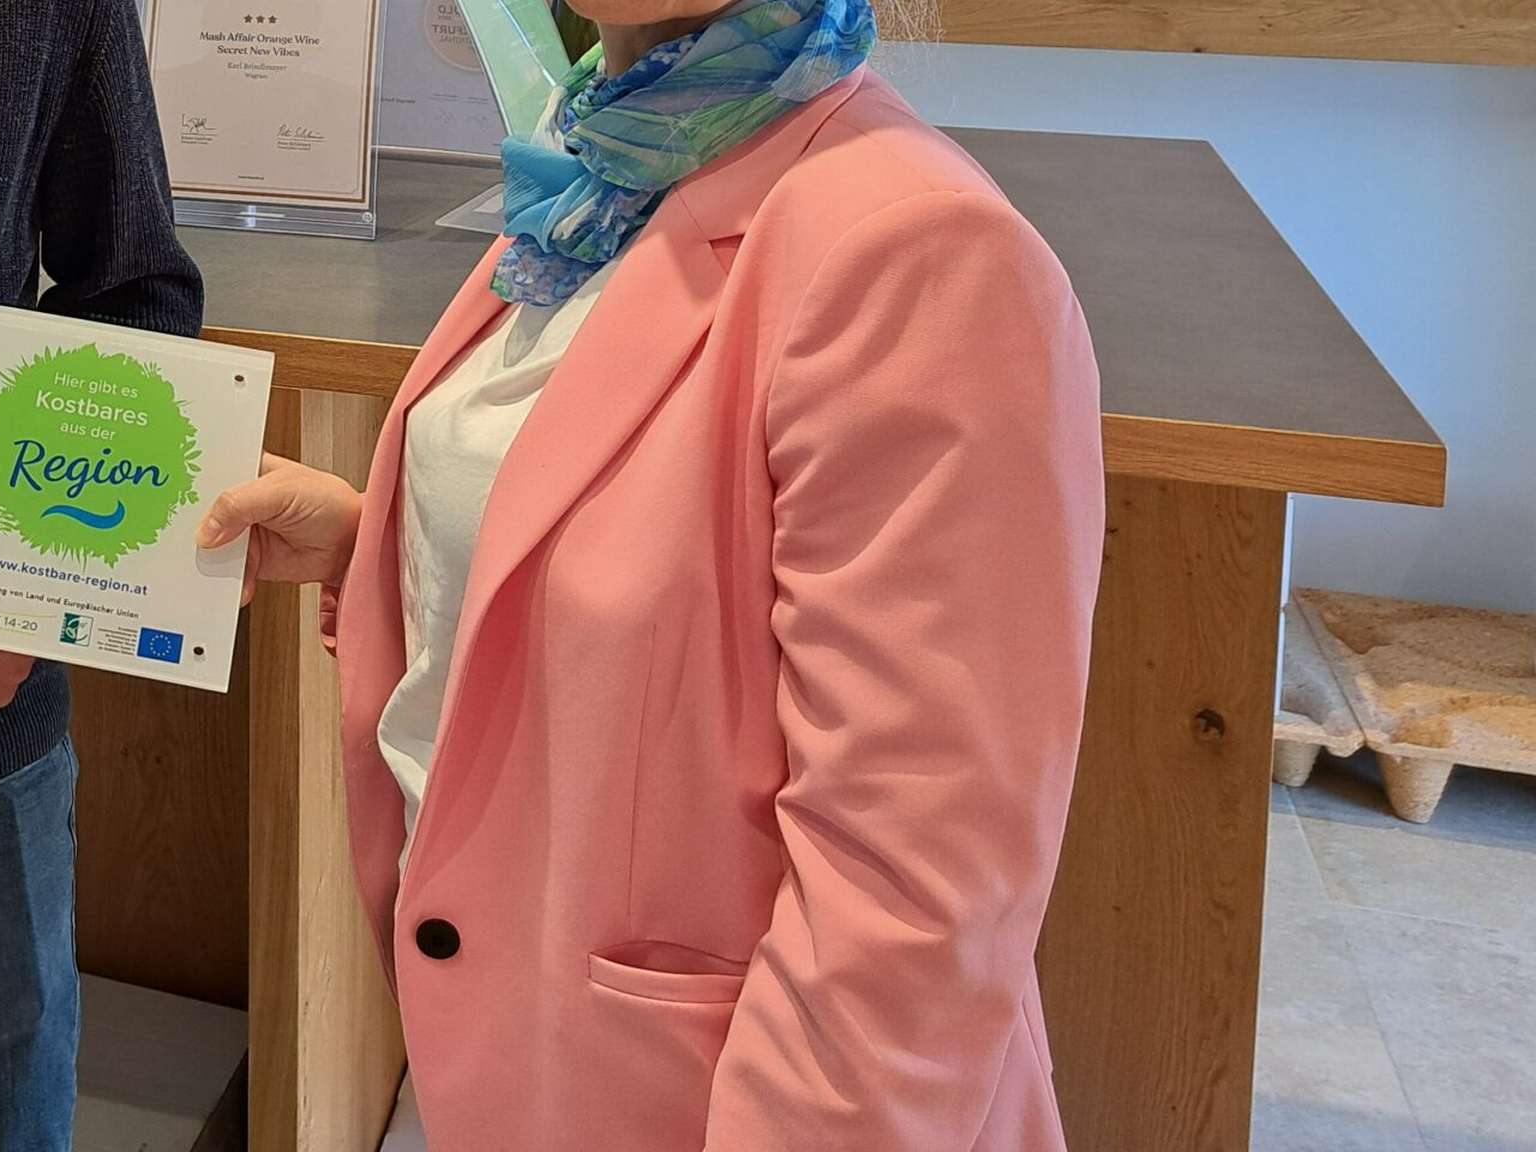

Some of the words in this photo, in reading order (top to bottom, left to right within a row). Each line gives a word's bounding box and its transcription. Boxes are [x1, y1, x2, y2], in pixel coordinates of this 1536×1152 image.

[199, 31, 225, 42] Mash
[227, 32, 256, 43] Affair
[257, 33, 293, 45] Orange
[295, 34, 320, 45] Wine
[216, 45, 249, 56] Secret
[250, 46, 271, 56] New
[272, 46, 301, 57] Vibes
[54, 372, 85, 389] Hier
[88, 379, 118, 398] gibt
[122, 386, 139, 398] es
[35, 390, 149, 427] Kostbares
[59, 422, 88, 436] aus
[91, 425, 116, 441] der
[9, 439, 169, 498] Region
[9, 590, 24, 599] von
[26, 591, 45, 603] Land
[46, 595, 62, 606] und
[63, 597, 114, 615] Europäischer
[116, 607, 140, 619] Union
[4, 616, 38, 632] 14-20
